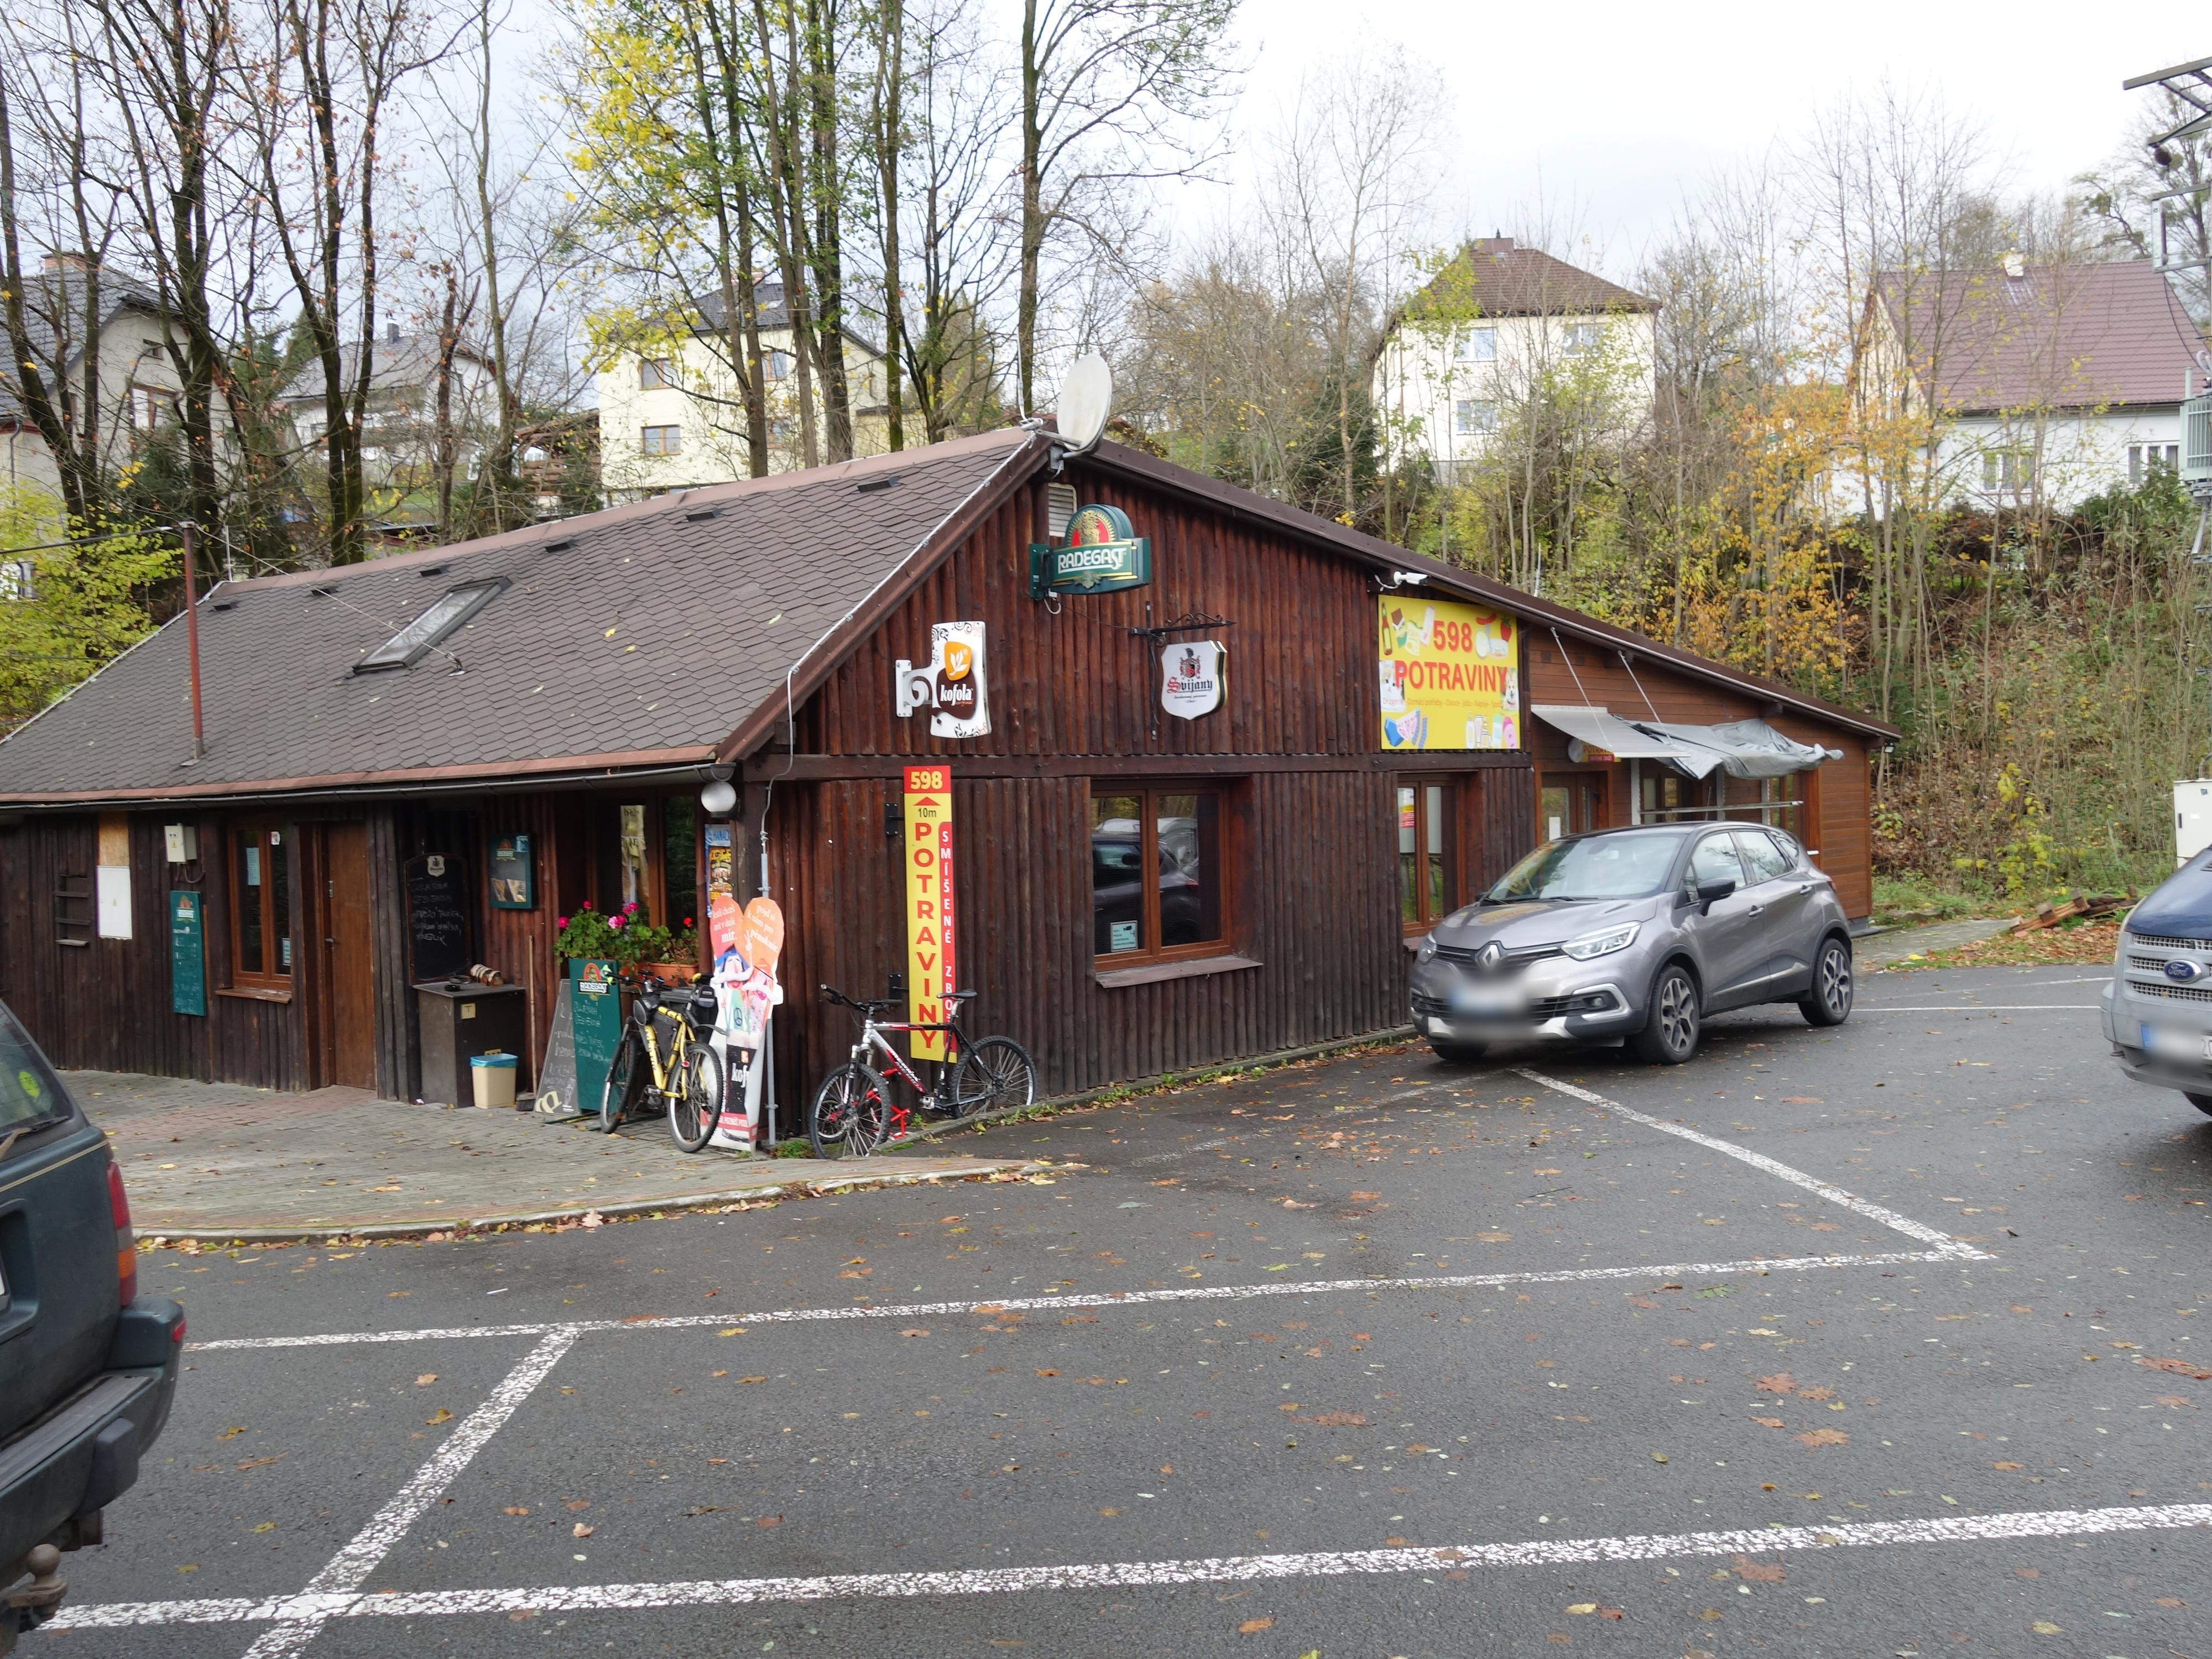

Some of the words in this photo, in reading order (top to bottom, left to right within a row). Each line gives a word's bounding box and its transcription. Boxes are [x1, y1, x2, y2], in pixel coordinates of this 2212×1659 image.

[1058, 547, 1127, 573] RADEGAST
[1433, 620, 1473, 653] 598
[1167, 676, 1212, 693] Svijany
[1395, 660, 1508, 693] POTRAVINY
[940, 684, 972, 706] kofola
[910, 771, 942, 790] 598
[918, 808, 936, 817] 10m
[941, 831, 951, 943] SMÍŠENÉ
[914, 823, 937, 1048] POTRAVINY
[2168, 963, 2188, 977] Ford
[580, 982, 608, 994] RADEGAST
